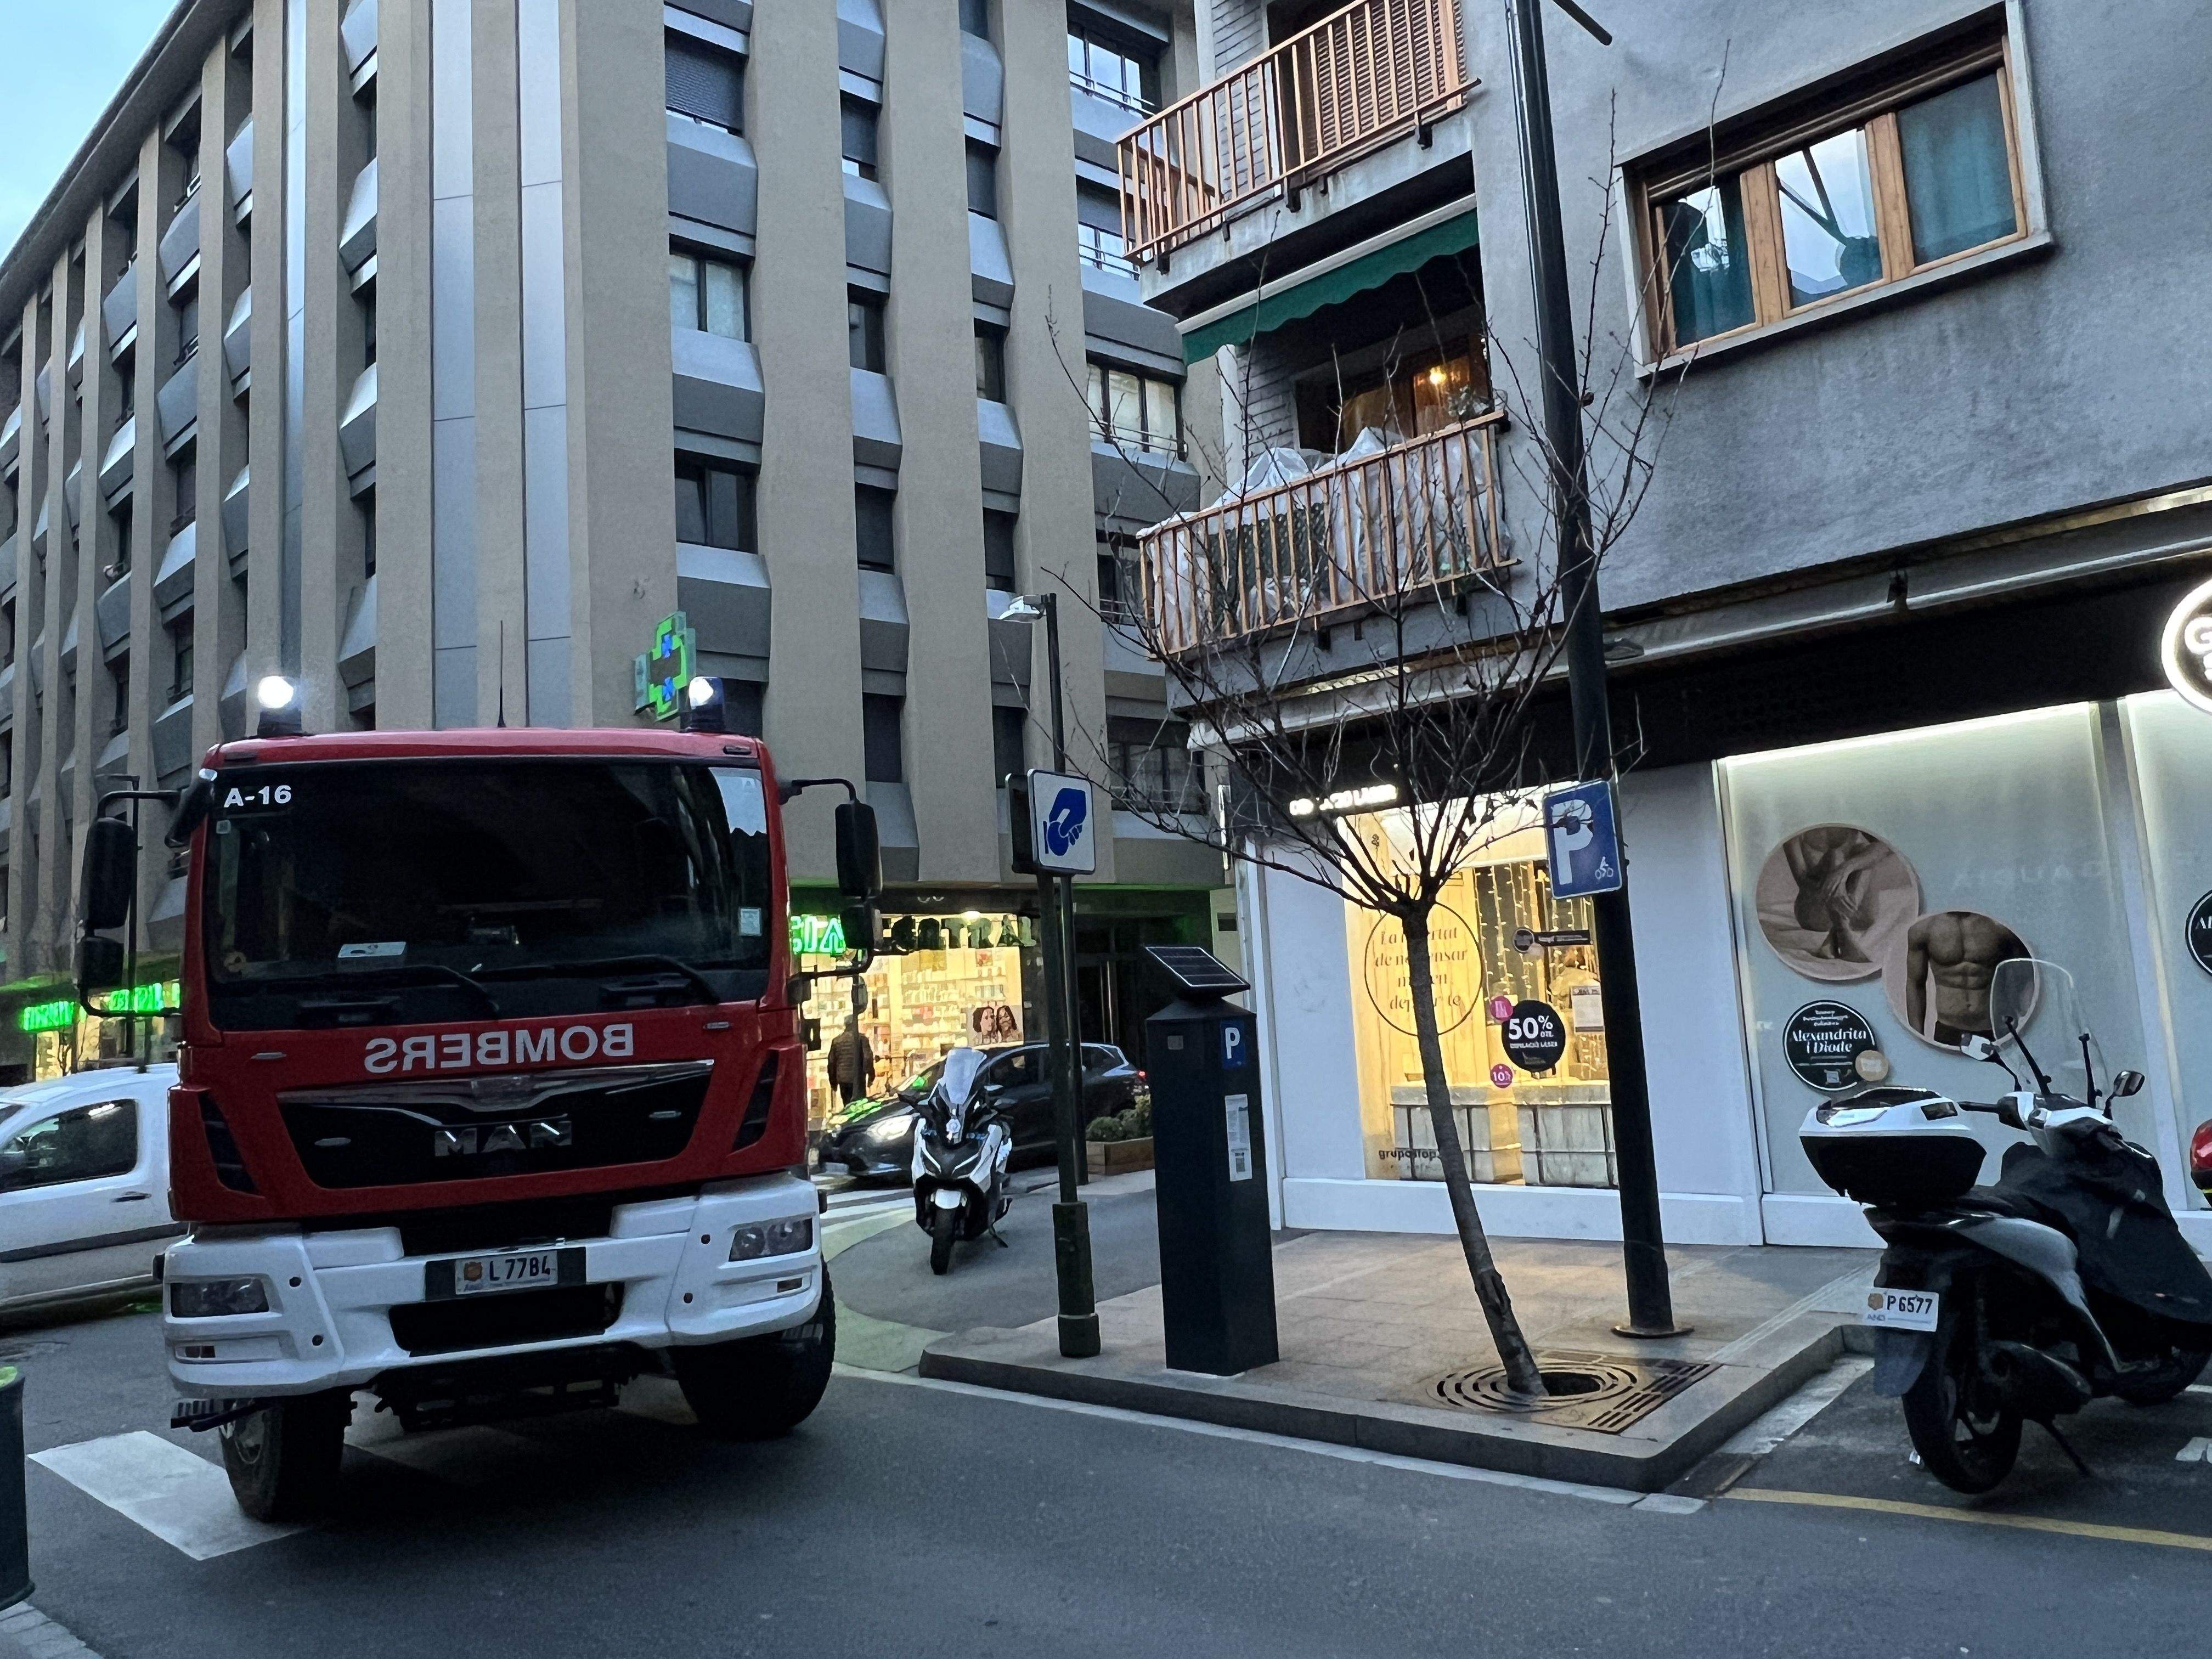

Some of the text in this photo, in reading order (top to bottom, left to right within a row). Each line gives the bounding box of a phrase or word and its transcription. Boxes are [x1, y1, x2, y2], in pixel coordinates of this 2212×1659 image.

[224, 785, 292, 808] A-16
[1551, 799, 1594, 885] P
[1224, 1027, 1240, 1059] P
[1509, 1015, 1553, 1040] 50%
[435, 1121, 572, 1157] MAN
